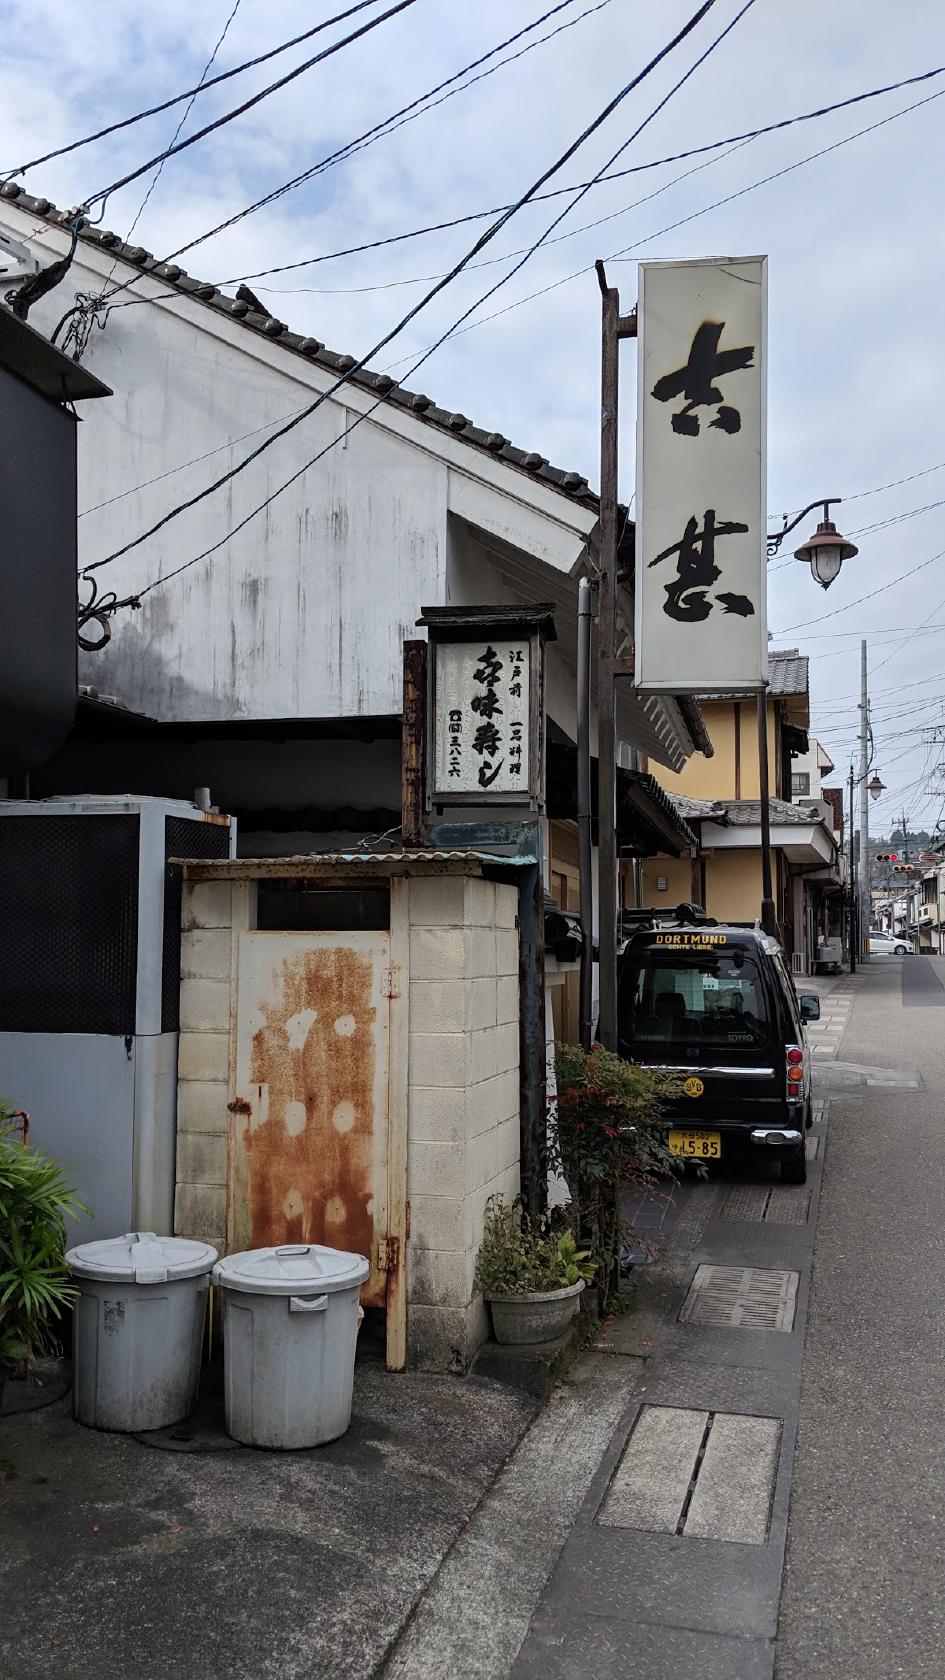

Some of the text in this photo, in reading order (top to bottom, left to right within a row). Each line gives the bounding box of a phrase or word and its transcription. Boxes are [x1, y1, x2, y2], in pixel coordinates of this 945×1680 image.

[508, 649, 525, 776] 江戸前 一品料理
[655, 934, 727, 944] DORTMUND
